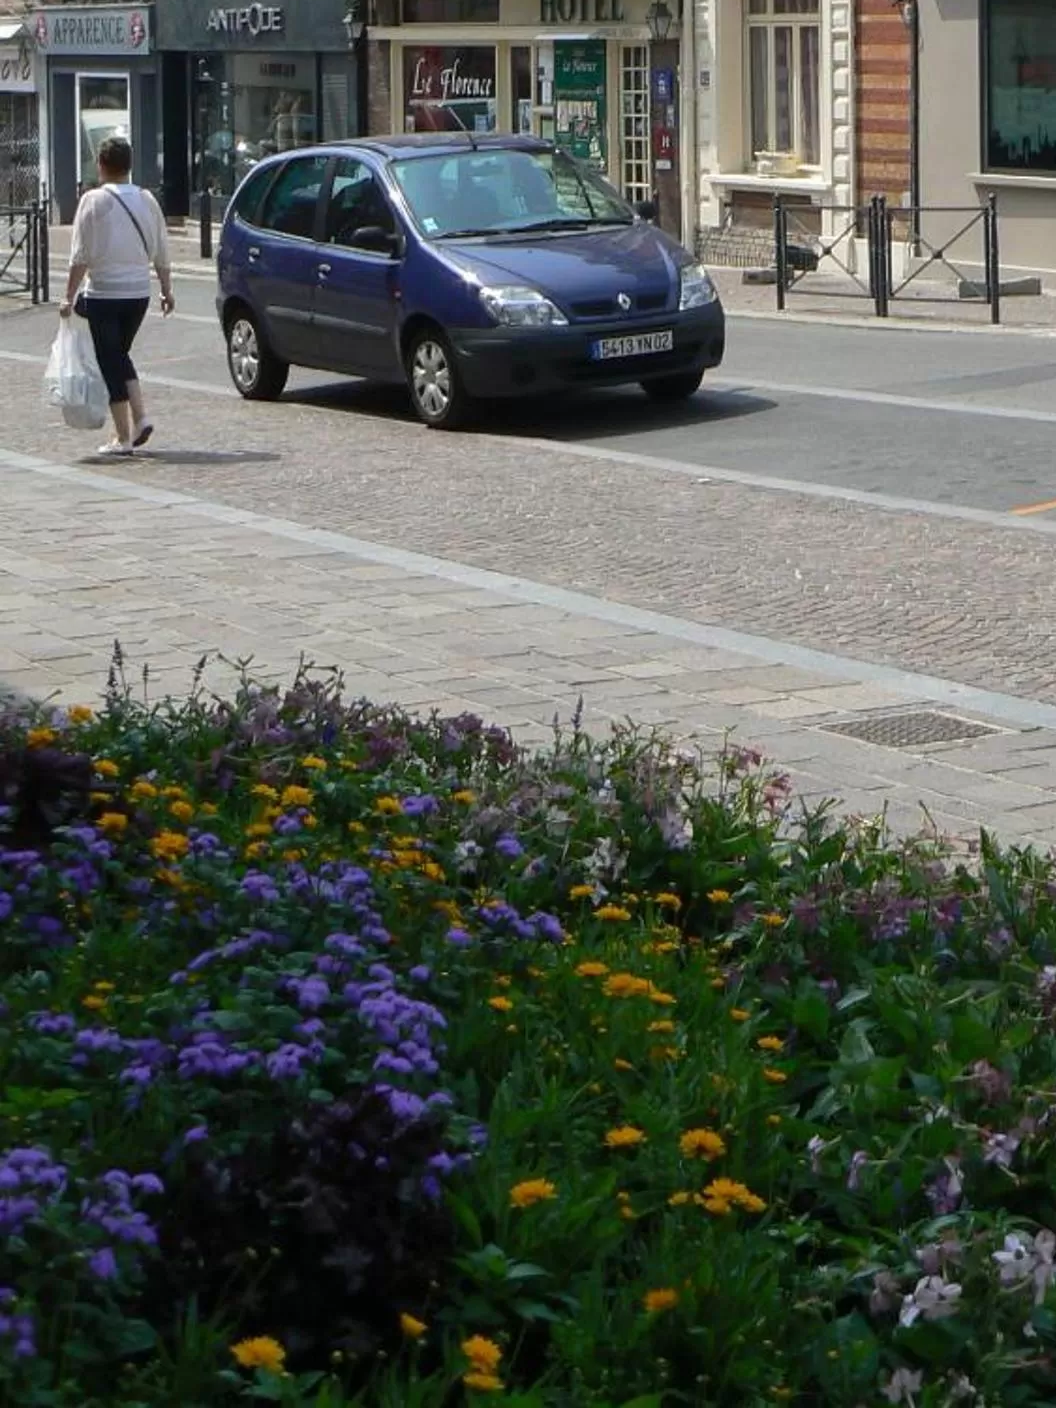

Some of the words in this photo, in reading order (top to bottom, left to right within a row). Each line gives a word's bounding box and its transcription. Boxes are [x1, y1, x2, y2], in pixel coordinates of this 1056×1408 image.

[53, 16, 125, 45] APPARENCE
[206, 2, 282, 36] ANTIPODE
[412, 57, 433, 94] Le
[439, 57, 493, 108] Florence
